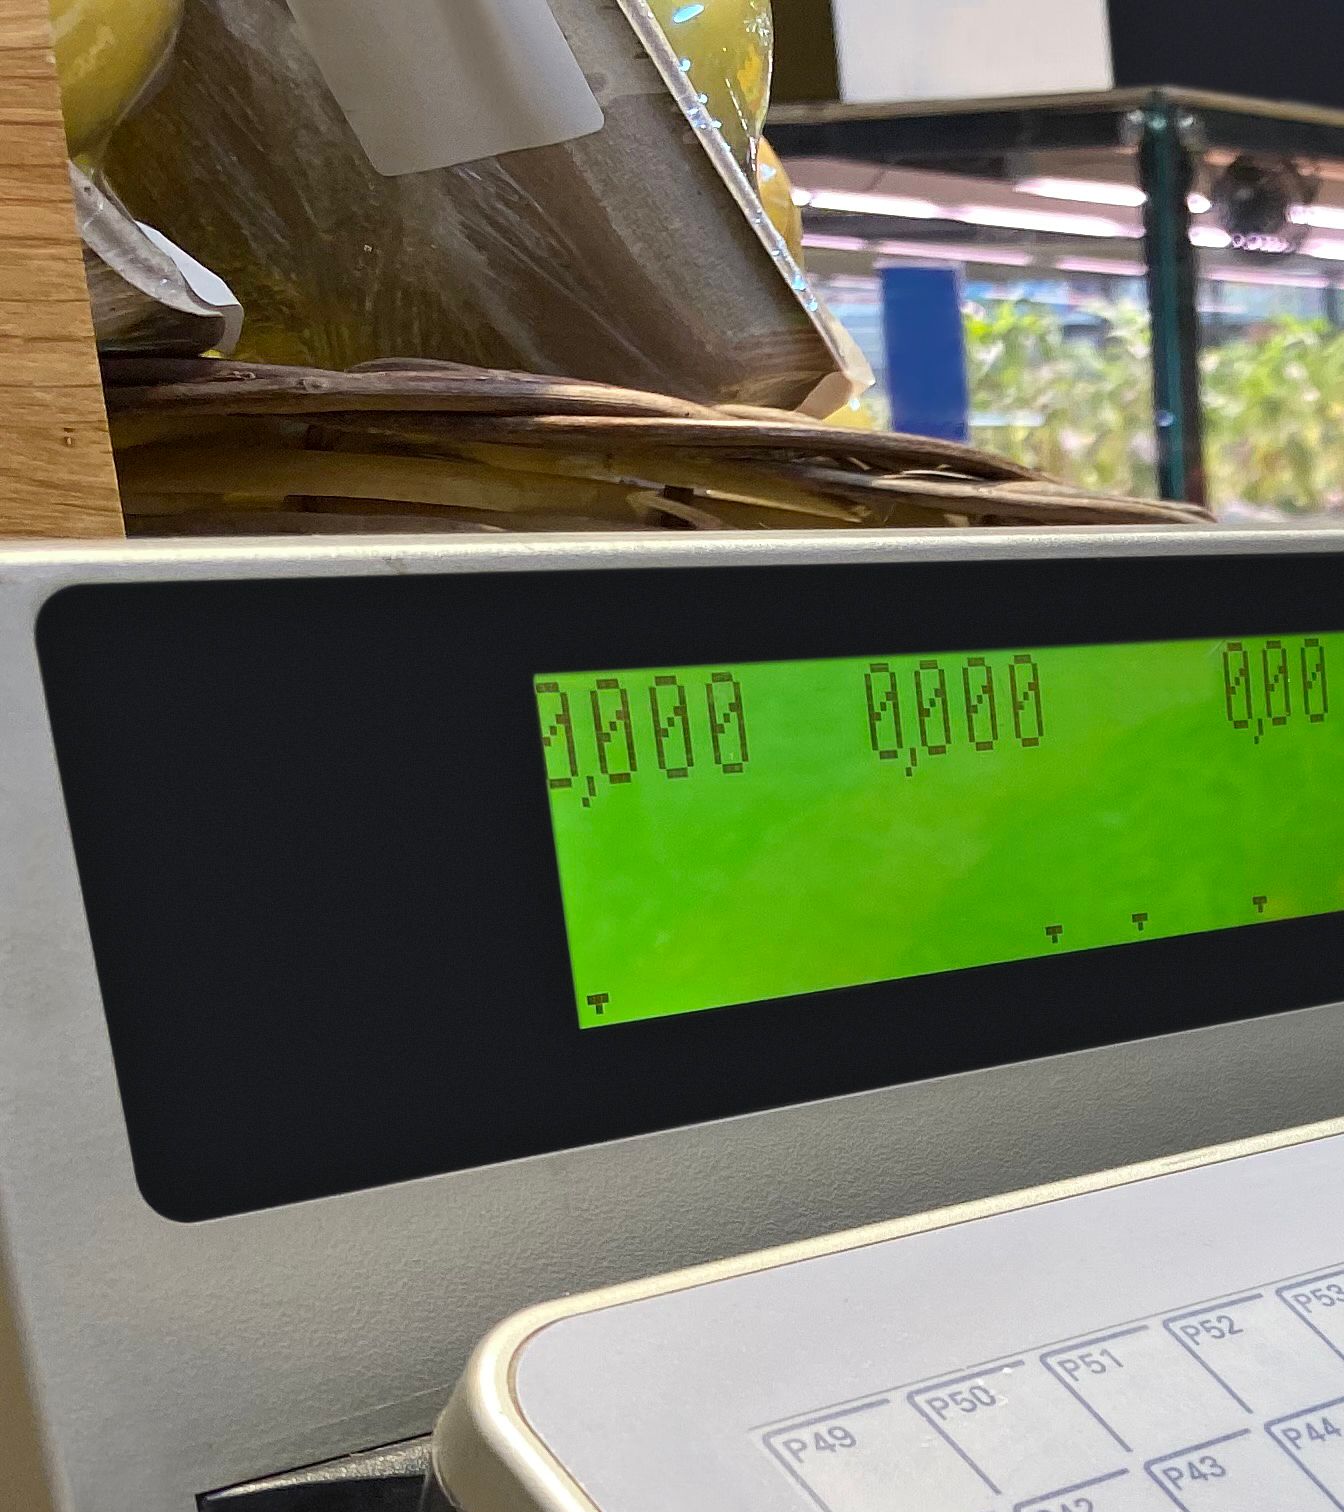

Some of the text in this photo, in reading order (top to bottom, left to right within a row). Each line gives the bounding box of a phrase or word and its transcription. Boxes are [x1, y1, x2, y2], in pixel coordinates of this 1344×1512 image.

[865, 655, 1044, 777] 0,000
[1223, 638, 1328, 744] 0,00
[782, 1426, 857, 1463] P49
[925, 1384, 997, 1421] P50
[1057, 1348, 1124, 1382] P51
[1180, 1315, 1243, 1345] P52
[1162, 1456, 1227, 1491] P43
[1281, 1417, 1341, 1449] P44
